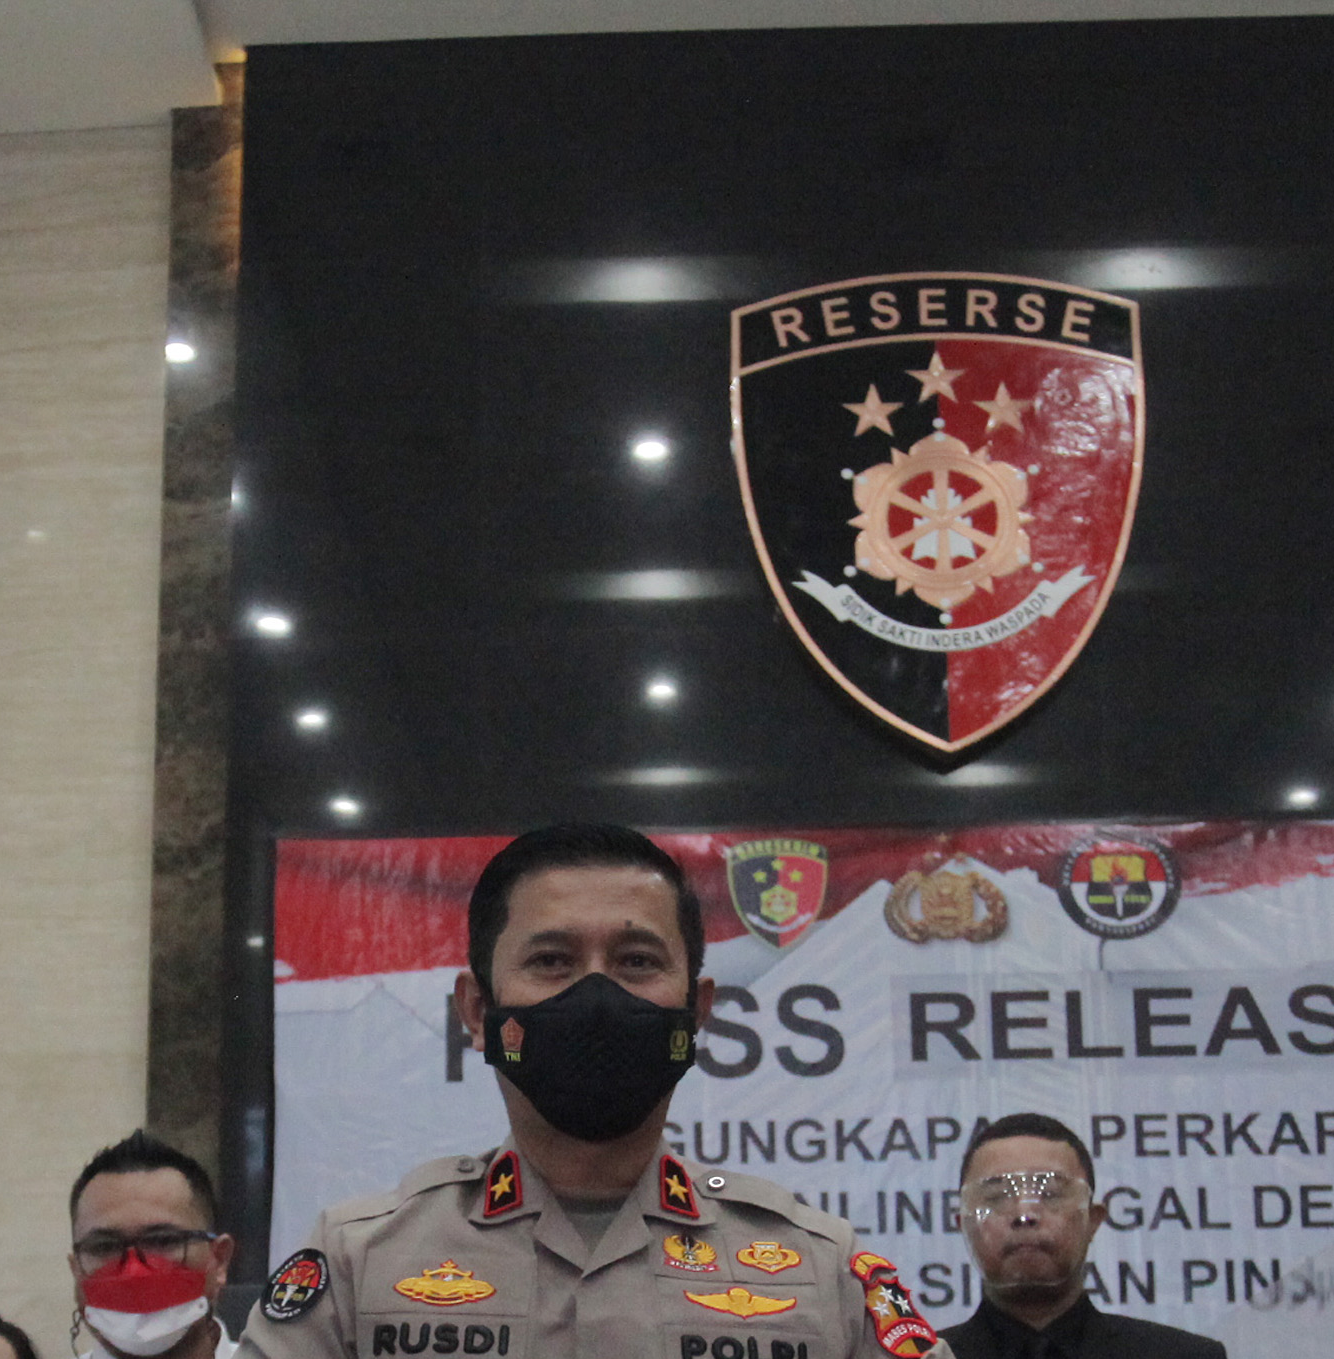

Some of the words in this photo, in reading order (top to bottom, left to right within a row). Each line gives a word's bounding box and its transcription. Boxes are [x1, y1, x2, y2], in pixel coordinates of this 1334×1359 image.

[771, 288, 1095, 347] RESERSE
[840, 594, 873, 628] SIDIK
[876, 620, 922, 645] SAKTI
[924, 629, 984, 648] INDERA
[985, 591, 1051, 641] WASPADA
[373, 1322, 511, 1357] RUSDI
[882, 1323, 908, 1348] MABES
